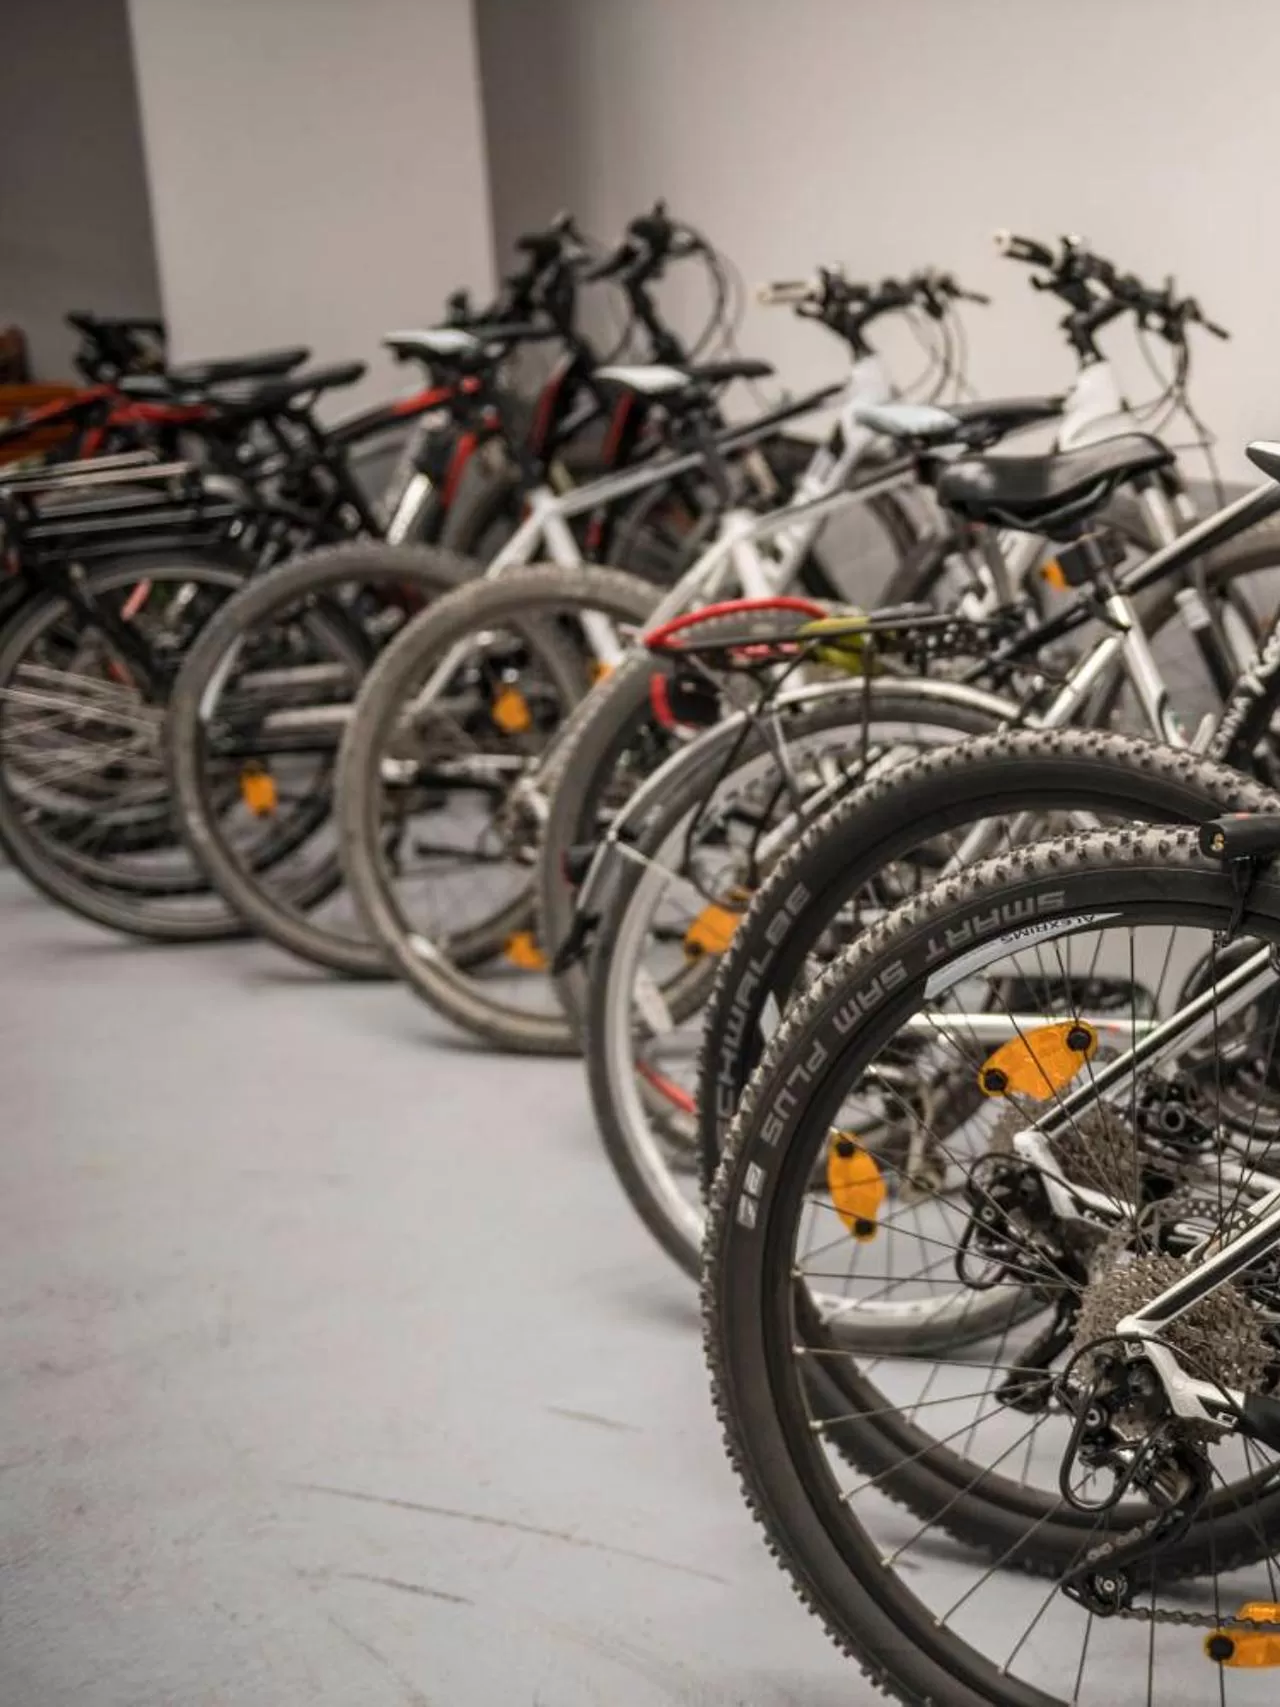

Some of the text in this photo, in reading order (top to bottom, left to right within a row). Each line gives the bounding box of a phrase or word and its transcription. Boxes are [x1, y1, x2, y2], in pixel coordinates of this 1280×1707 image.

[1208, 696, 1250, 760] ENNA
[760, 890, 1065, 1148] SMART SAM PLUS
